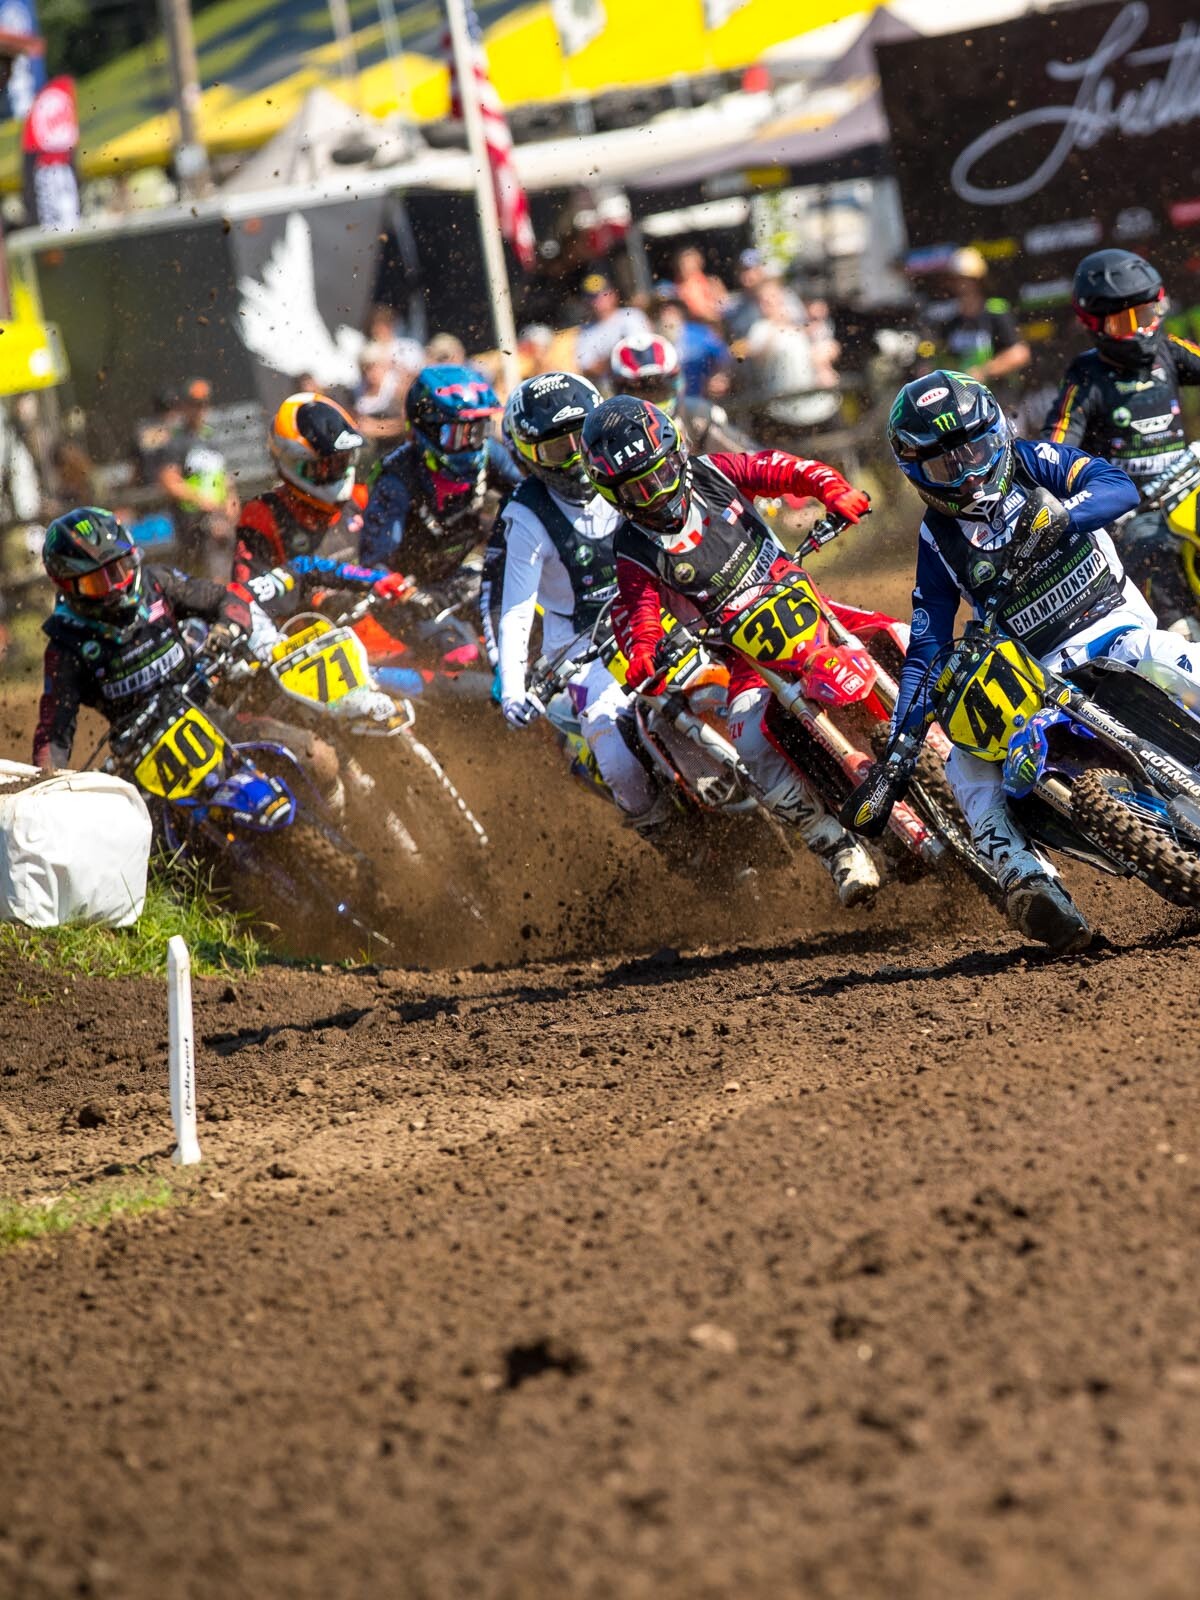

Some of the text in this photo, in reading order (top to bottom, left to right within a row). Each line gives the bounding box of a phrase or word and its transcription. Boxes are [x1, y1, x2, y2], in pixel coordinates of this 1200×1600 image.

[921, 390, 944, 404] BELL
[613, 438, 646, 466] FLY
[1003, 595, 1031, 618] AMATEUR
[1031, 573, 1062, 600] NATIONAL
[1012, 552, 1101, 634] CHAMPIONSHIP
[743, 590, 820, 662] 36
[299, 646, 359, 702] 71
[963, 651, 1028, 749] 41
[155, 720, 217, 787] 40
